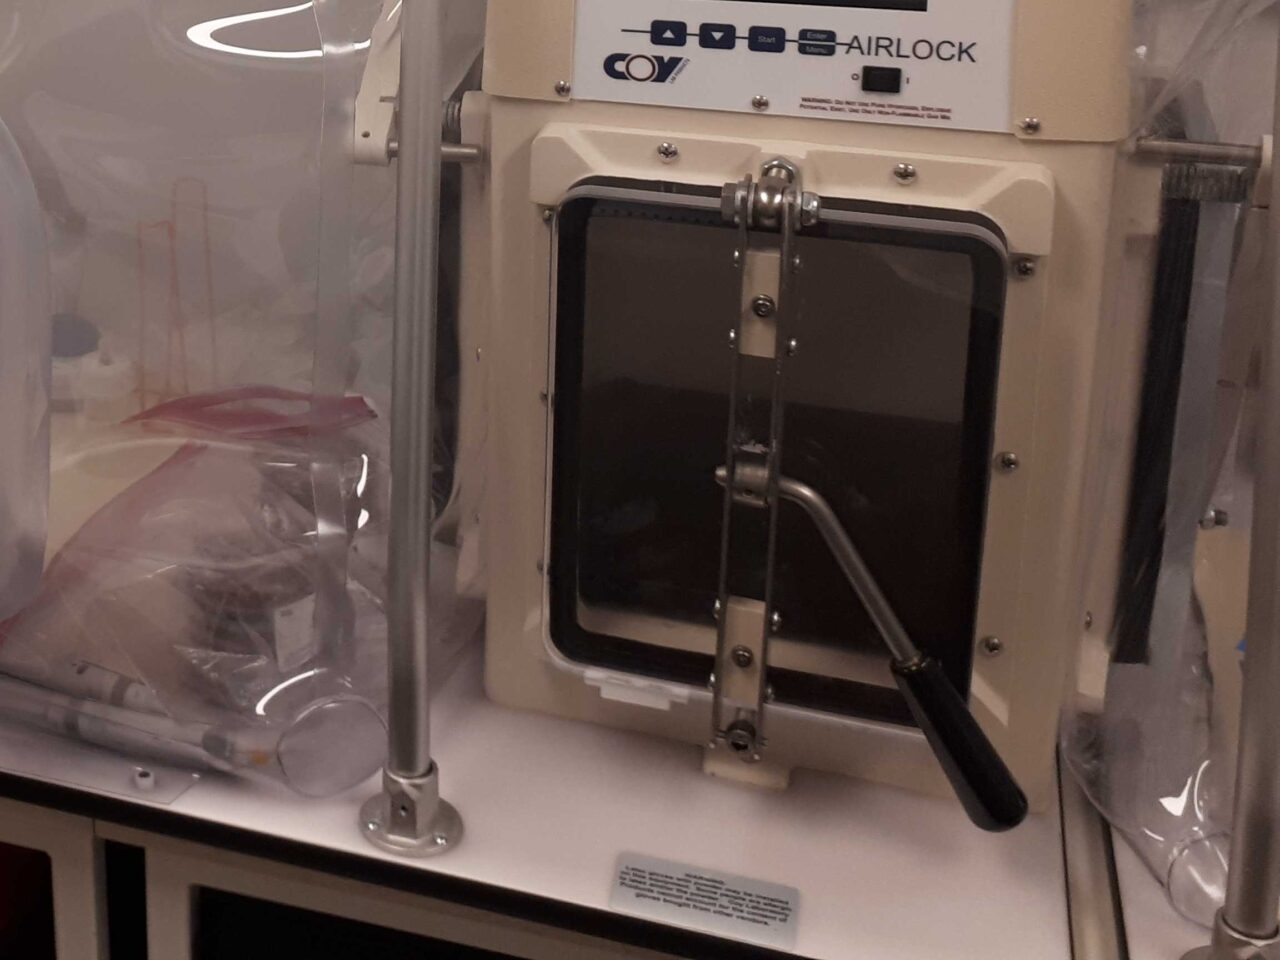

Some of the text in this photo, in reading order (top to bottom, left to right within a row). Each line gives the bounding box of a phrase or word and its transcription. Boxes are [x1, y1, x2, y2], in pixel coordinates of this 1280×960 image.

[758, 35, 776, 44] Start
[806, 31, 827, 40] Enter
[845, 35, 977, 63] AIRLOCK
[603, 53, 684, 83] COY
